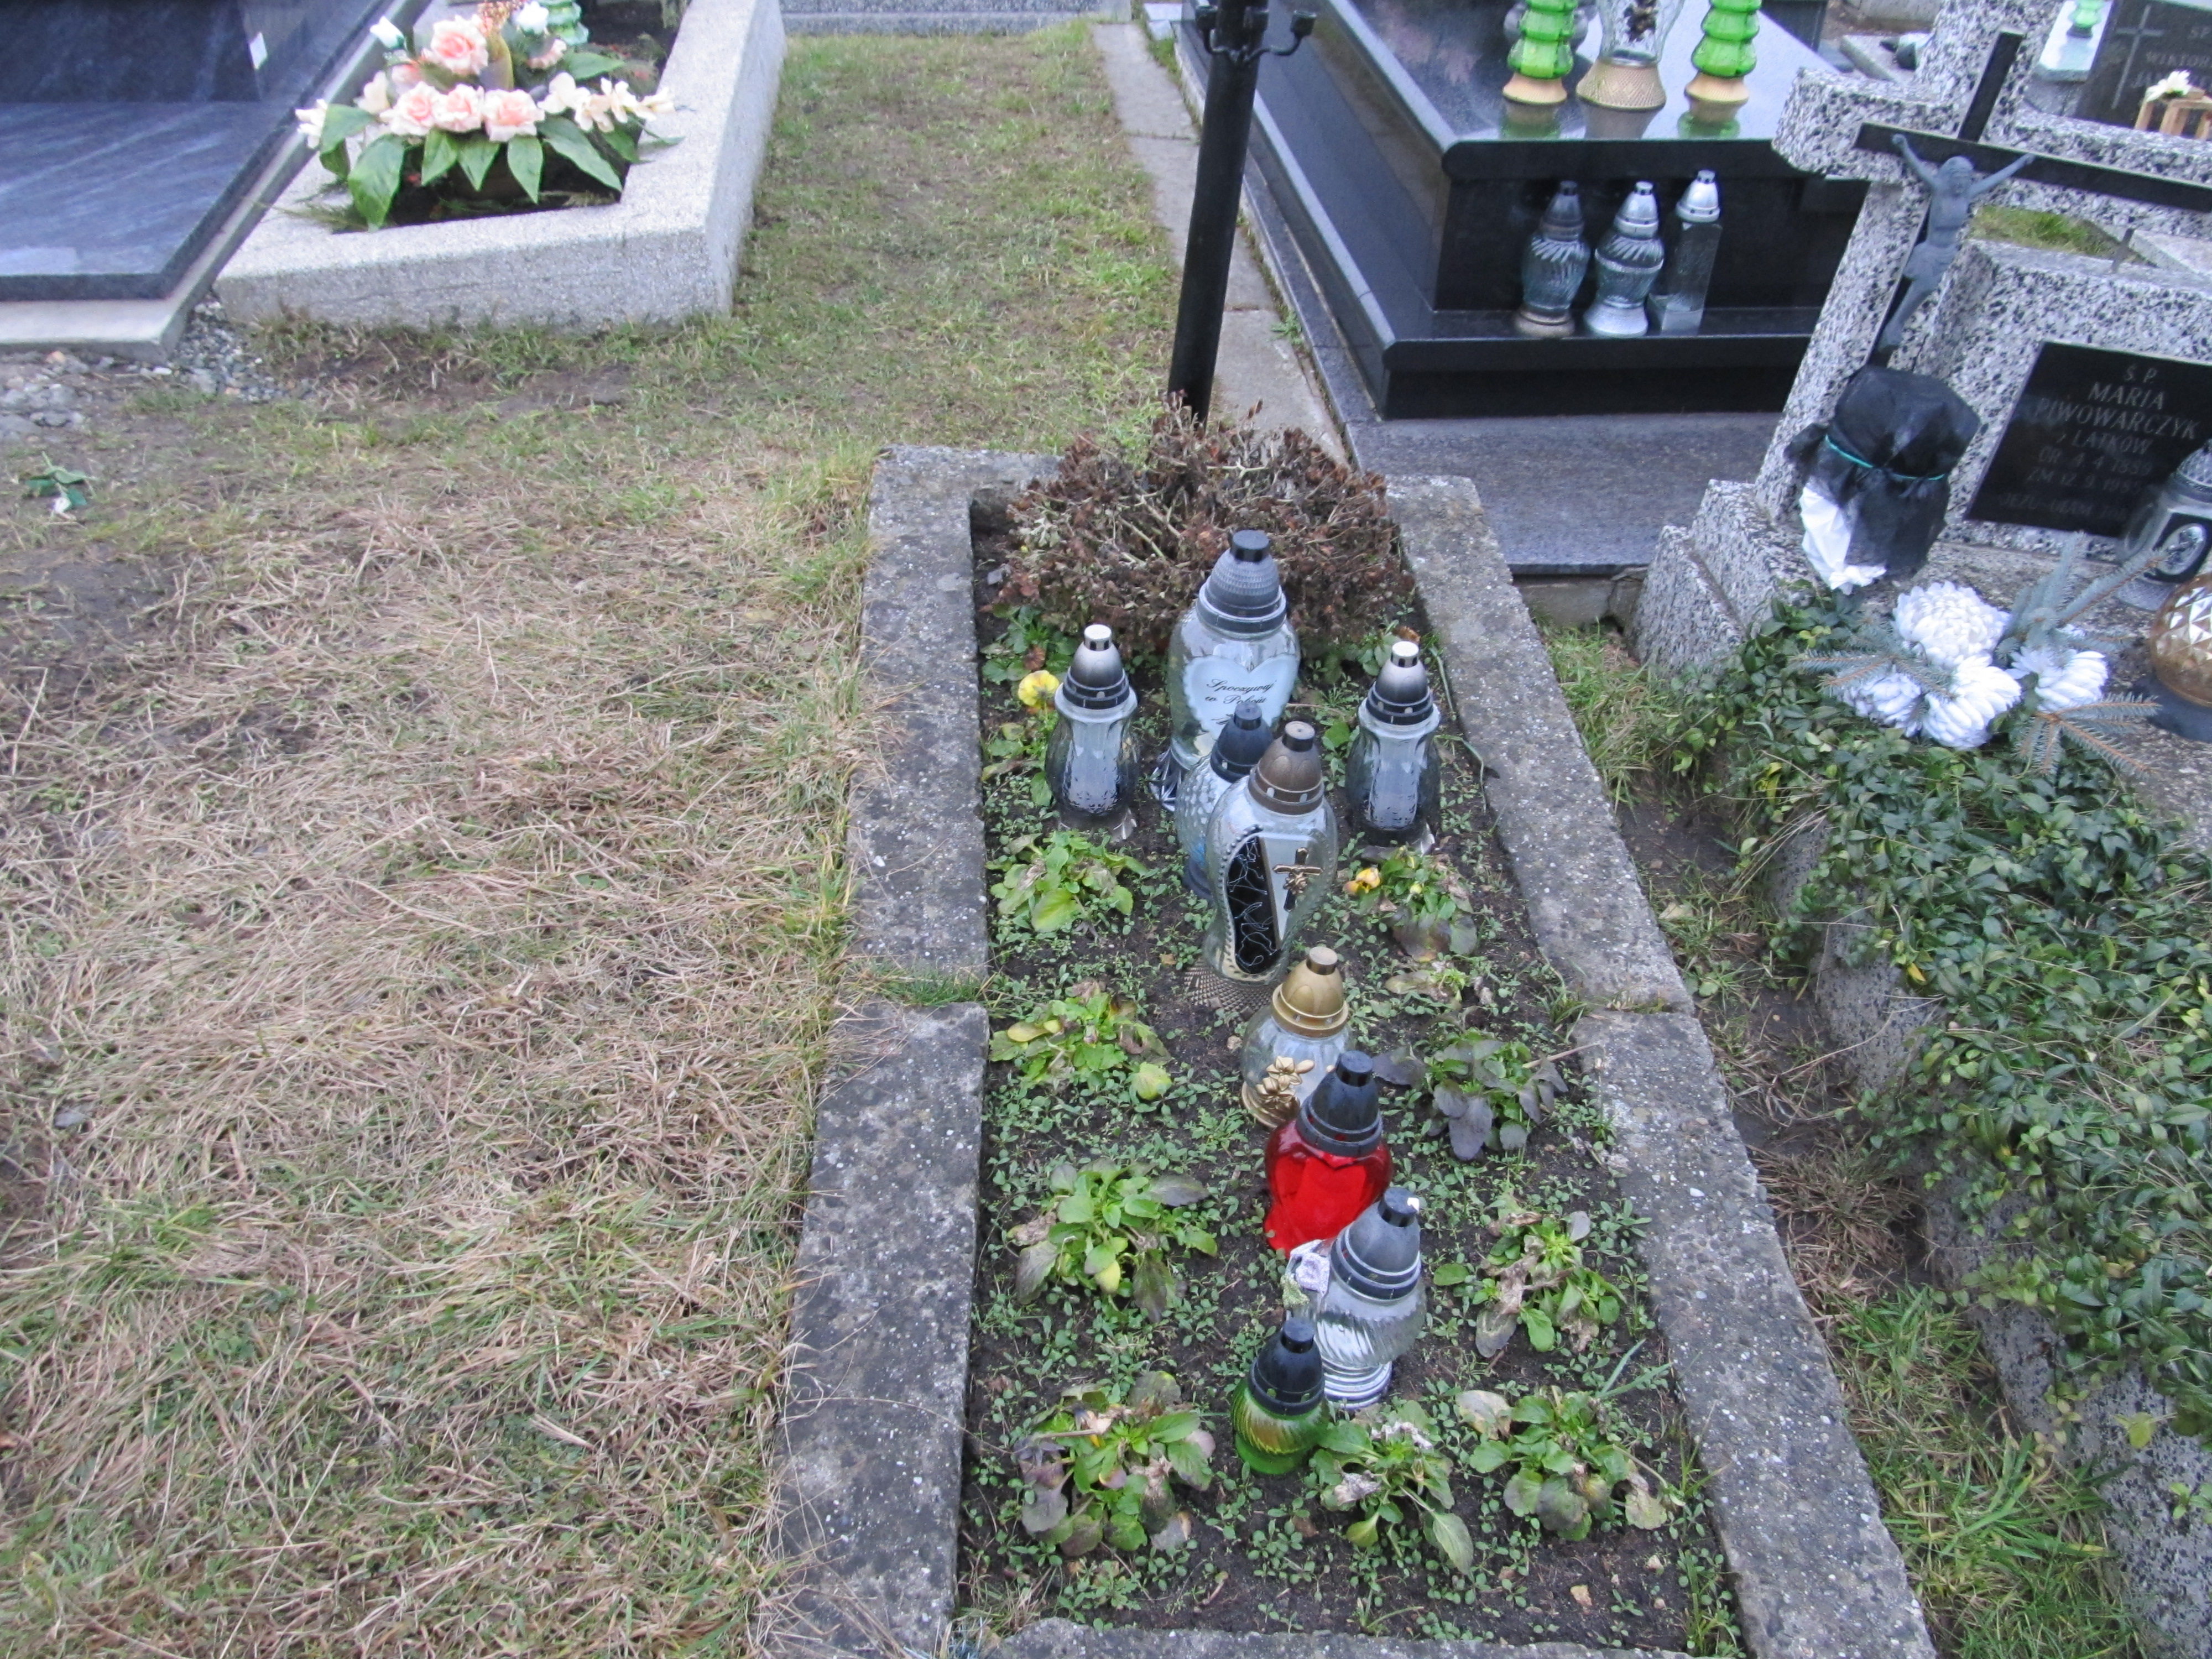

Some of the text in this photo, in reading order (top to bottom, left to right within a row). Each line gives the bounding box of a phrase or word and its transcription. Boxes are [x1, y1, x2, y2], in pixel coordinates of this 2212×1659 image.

[2088, 382, 2166, 410] MARIA
[2034, 397, 2200, 440] PIWOWARCZYK
[1206, 678, 1277, 695] Spoczywaj
